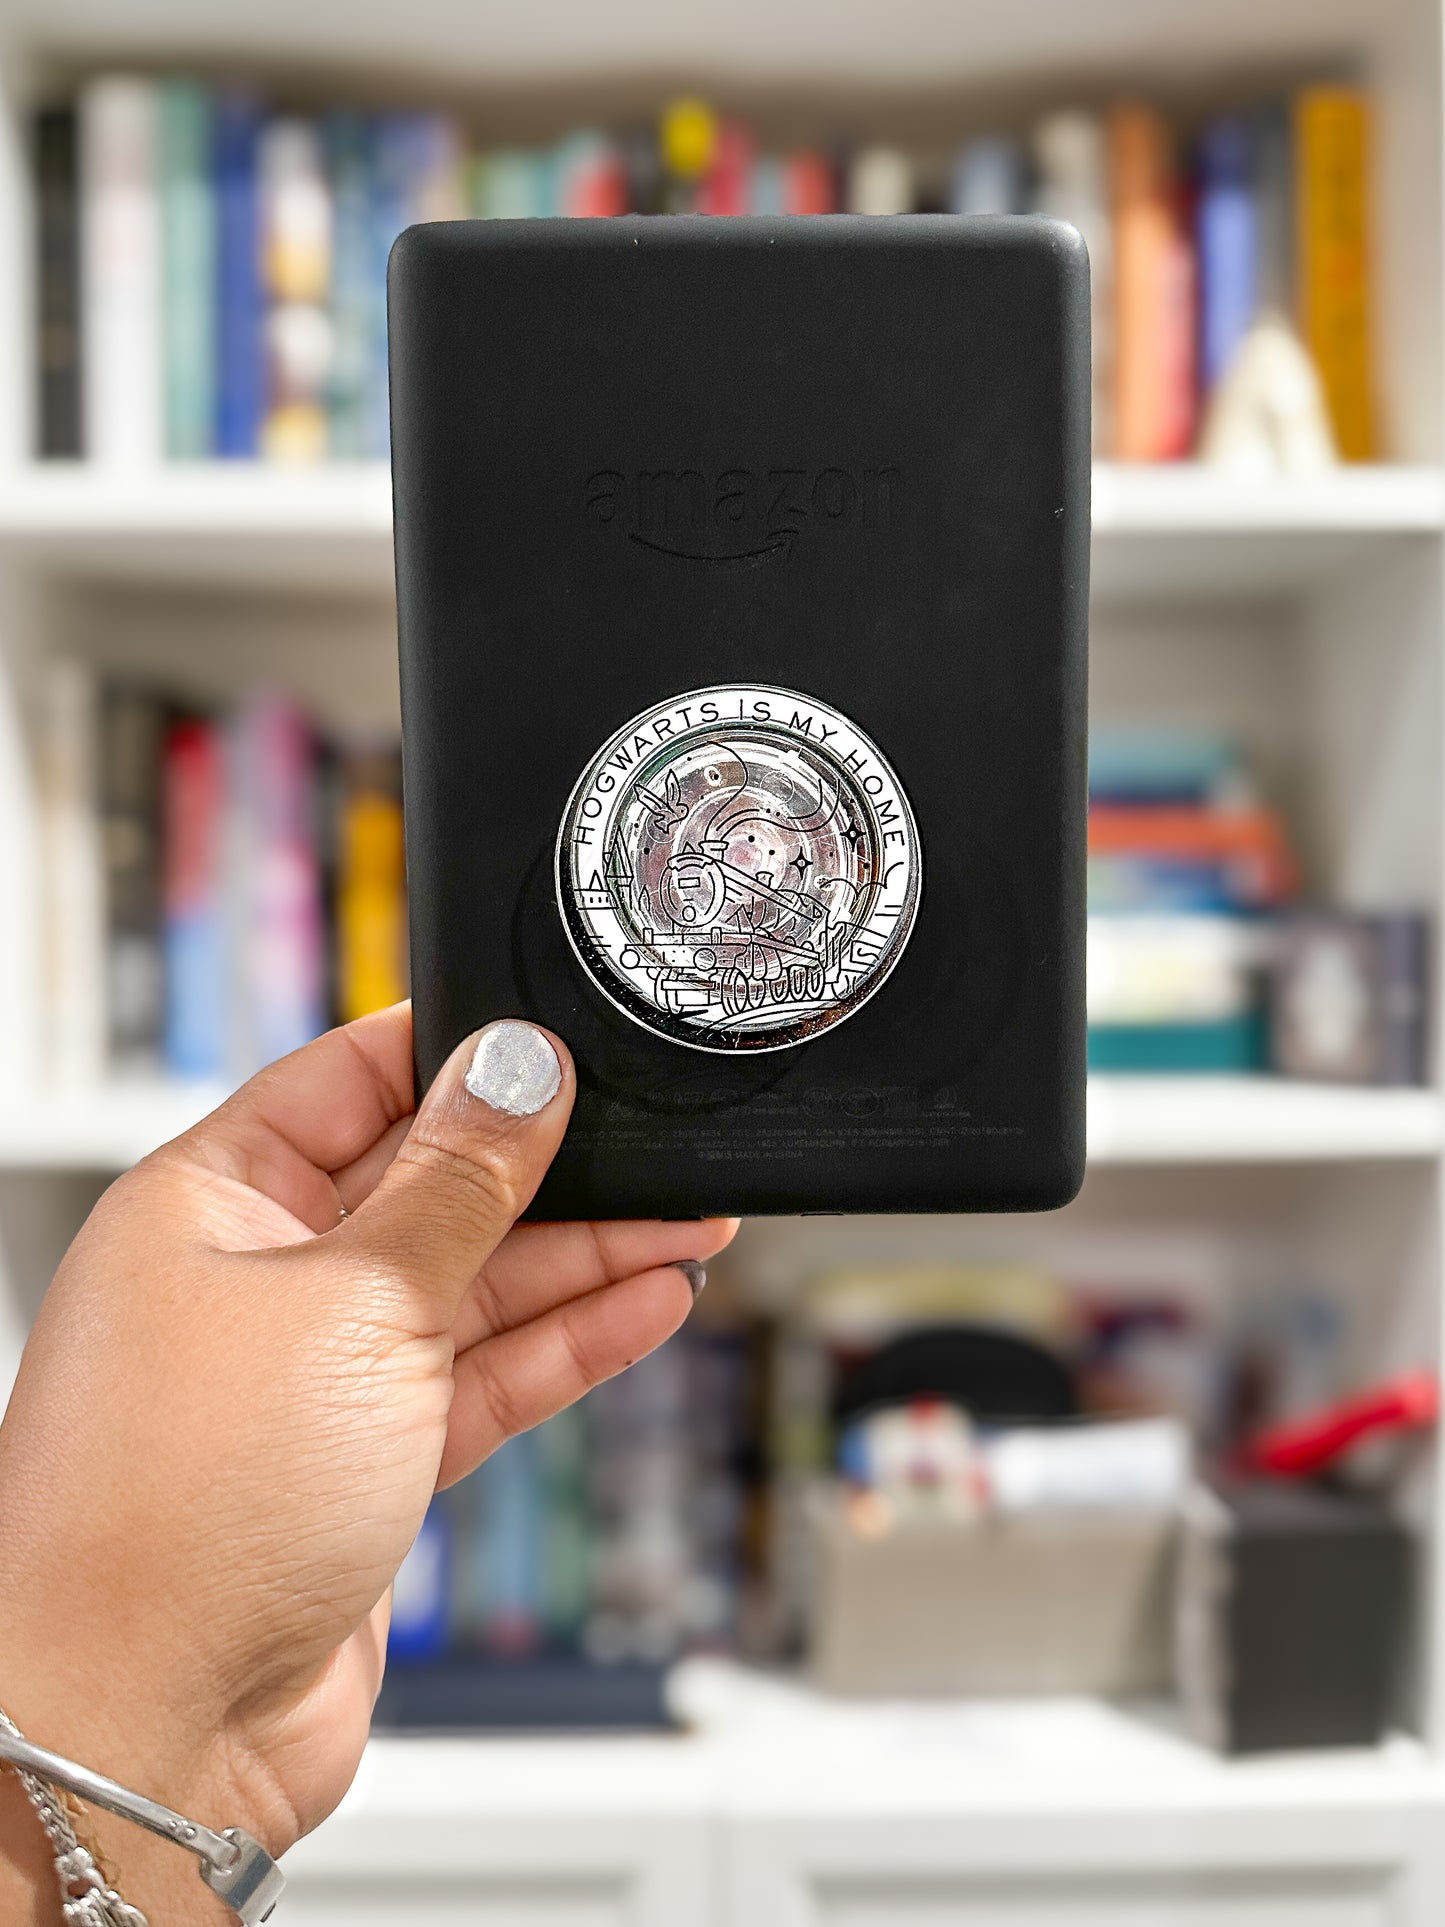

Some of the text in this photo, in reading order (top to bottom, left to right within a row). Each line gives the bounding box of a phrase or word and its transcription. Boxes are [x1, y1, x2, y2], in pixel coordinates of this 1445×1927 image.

[585, 468, 903, 525] amazon
[572, 698, 906, 849] HOGWARTS IS MY HOME
